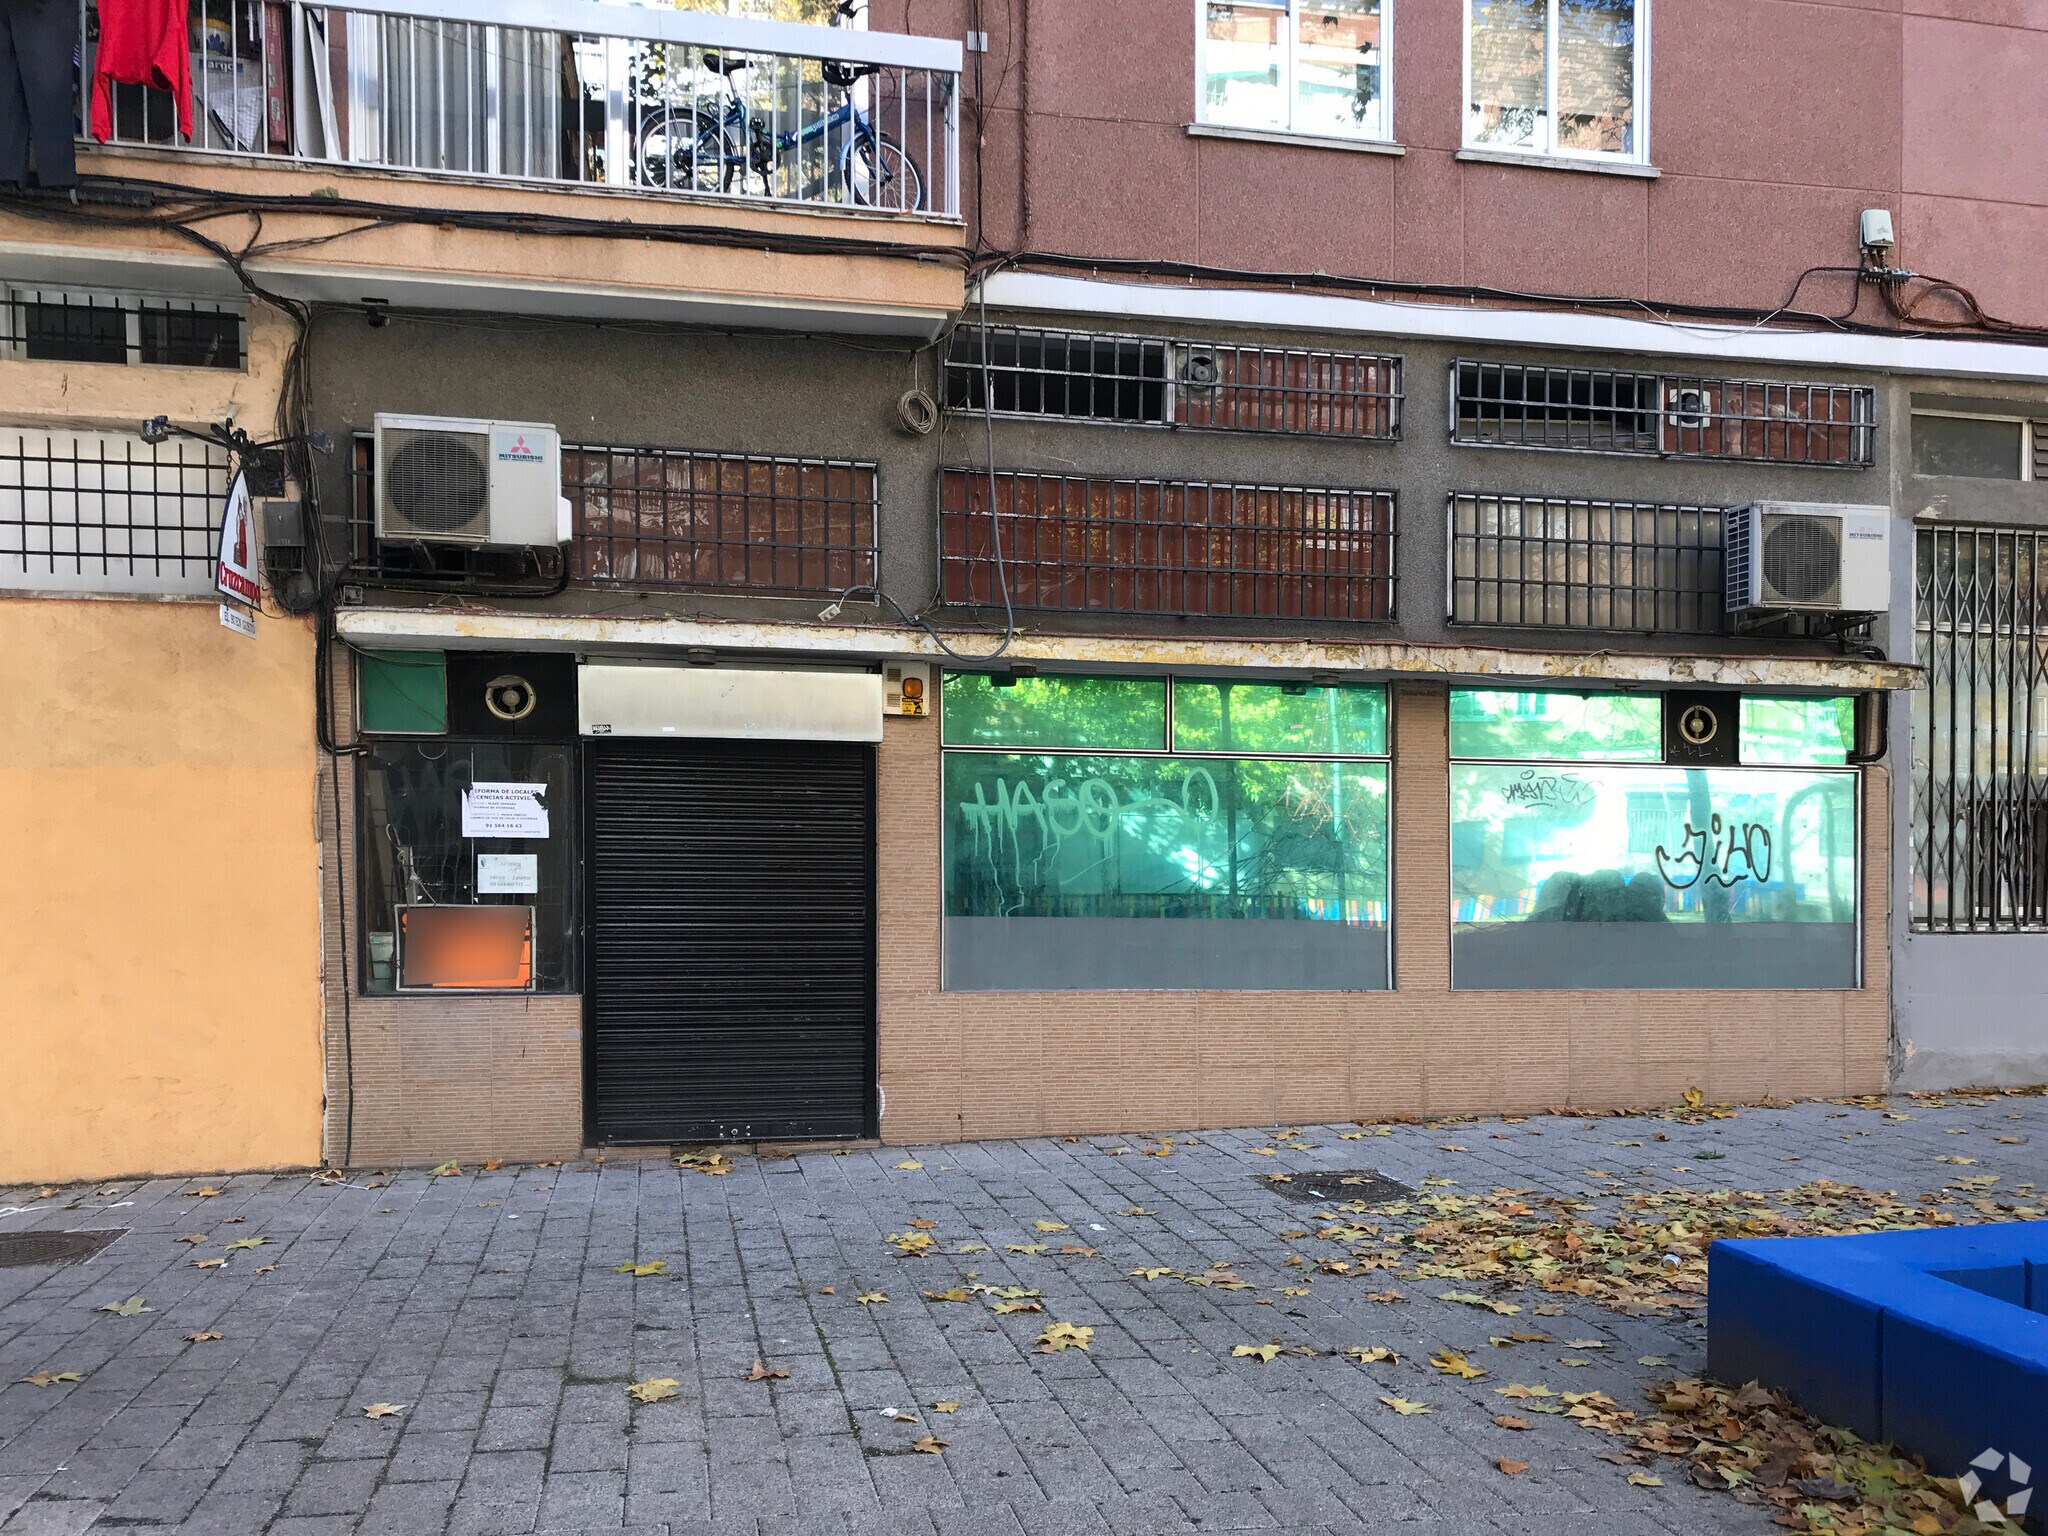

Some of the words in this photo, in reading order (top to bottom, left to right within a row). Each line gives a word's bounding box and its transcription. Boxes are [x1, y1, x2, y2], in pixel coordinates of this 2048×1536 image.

[220, 561, 260, 603] Cruzcampo
[224, 611, 230, 622] EL
[231, 614, 242, 628] BUEN
